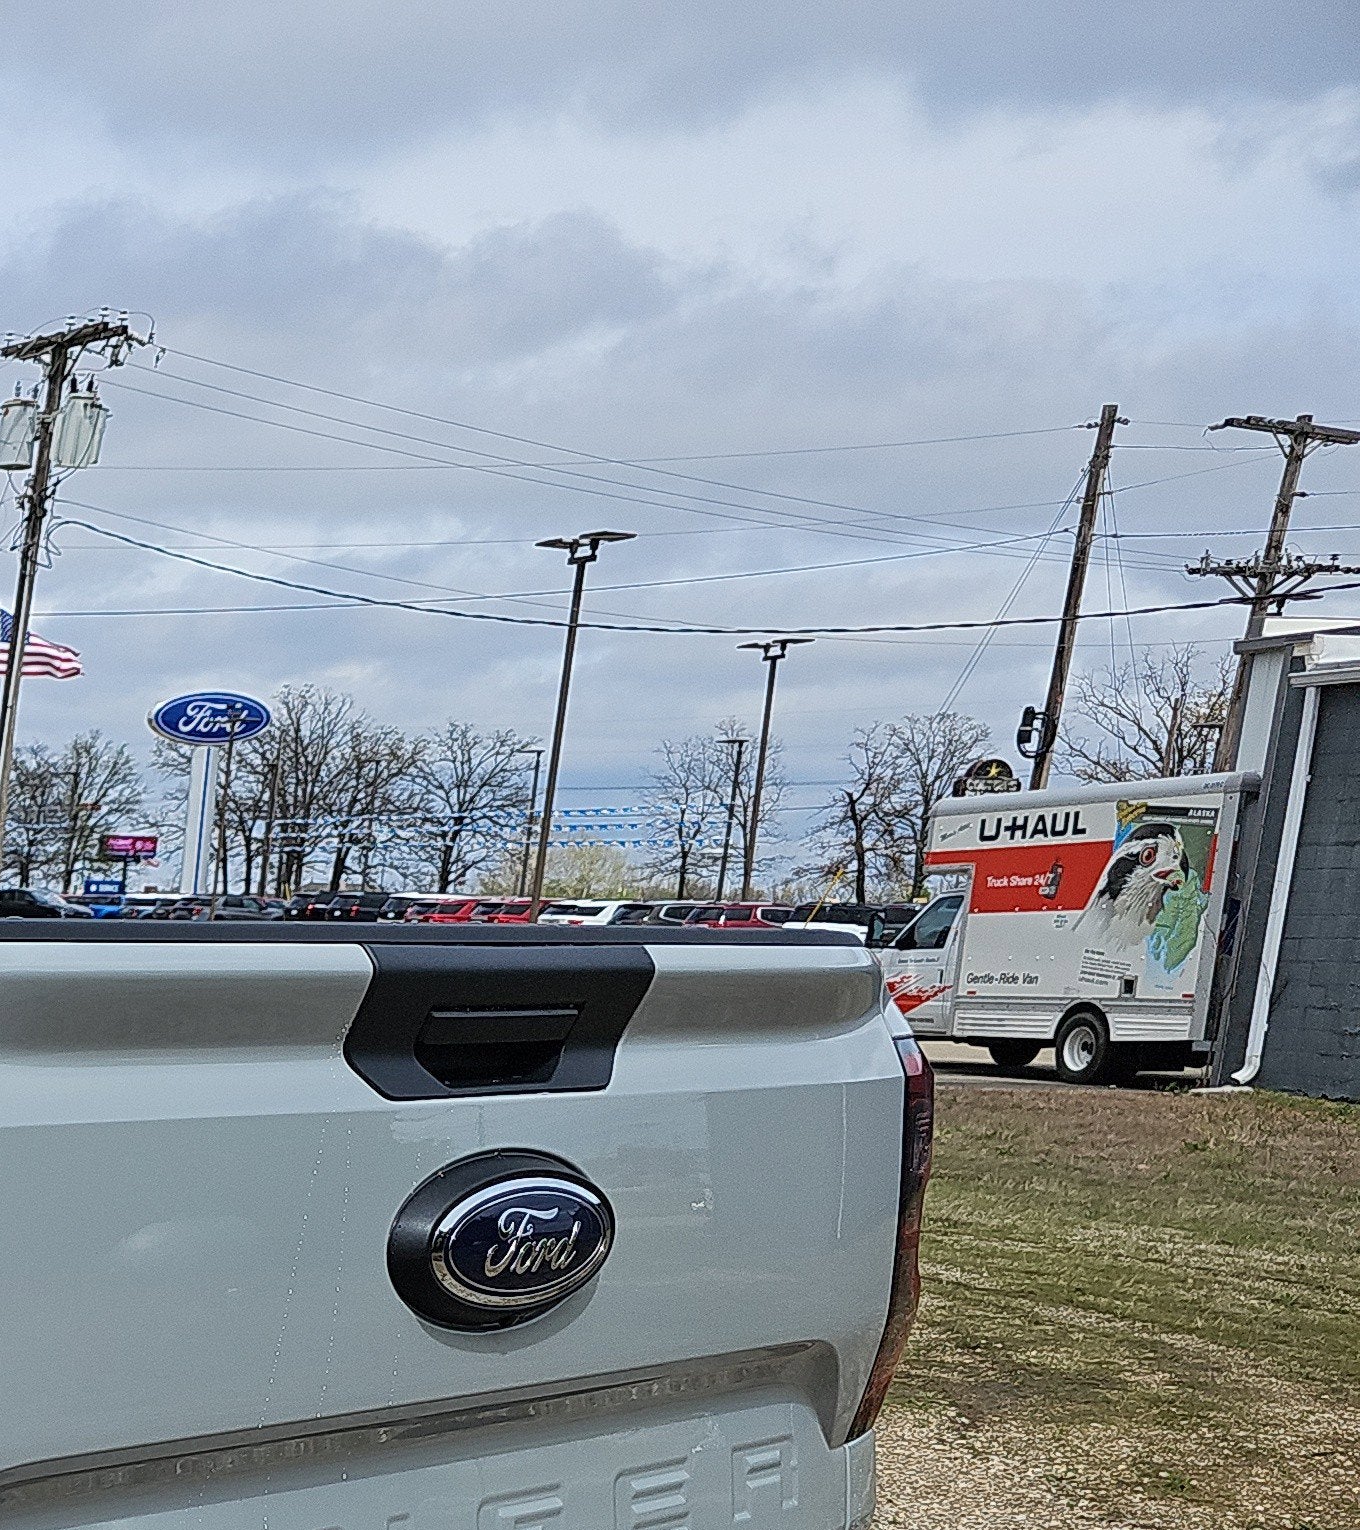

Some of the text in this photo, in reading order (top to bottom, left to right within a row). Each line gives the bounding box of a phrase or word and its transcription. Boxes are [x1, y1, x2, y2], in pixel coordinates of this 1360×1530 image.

[178, 700, 248, 734] Ford
[1187, 808, 1215, 817] ALASKA
[978, 810, 1087, 842] U-HAUL
[986, 872, 1055, 888] Truck Share 24/7
[966, 971, 1039, 985] Gentle-Ride Van
[483, 1206, 582, 1278] Ford
